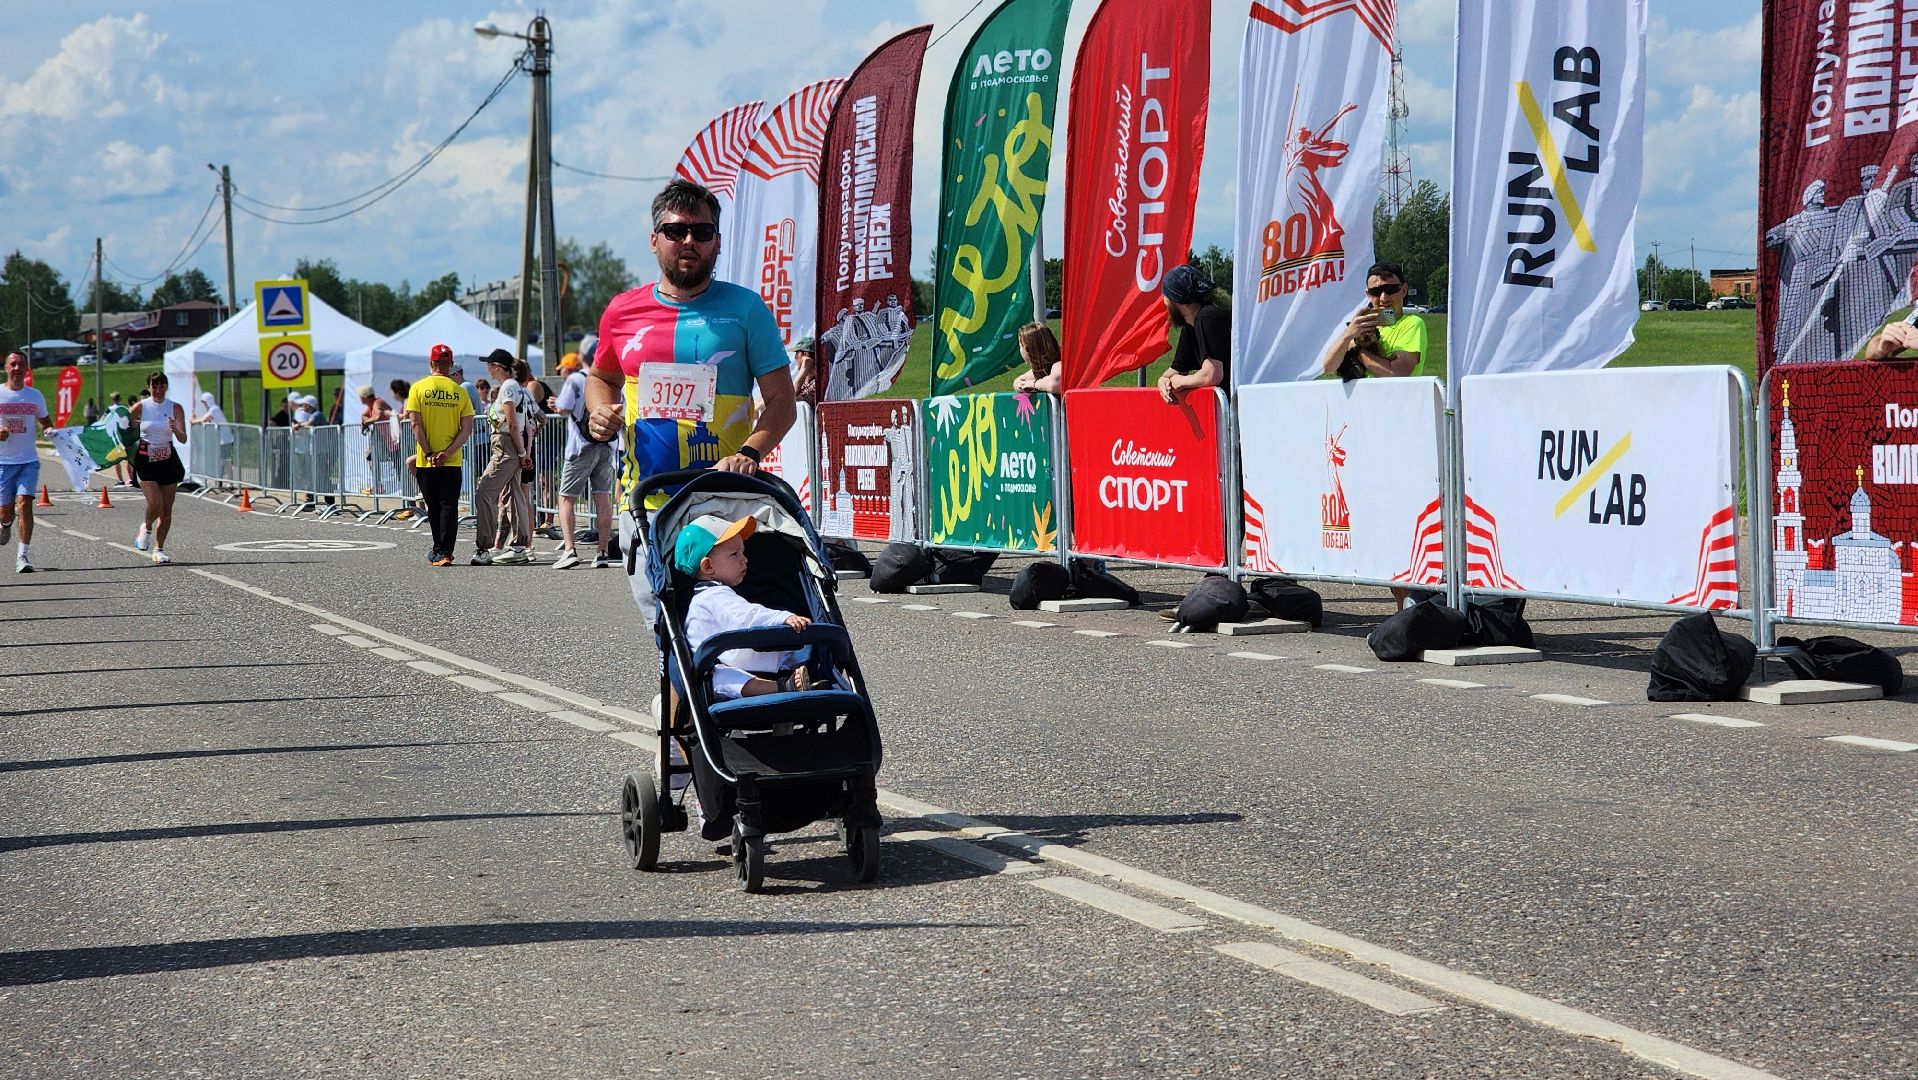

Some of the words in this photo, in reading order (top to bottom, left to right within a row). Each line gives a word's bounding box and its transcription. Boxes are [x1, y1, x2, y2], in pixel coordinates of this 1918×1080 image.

[1553, 46, 1600, 174] LAB
[1106, 84, 1132, 258] Советский
[1136, 53, 1170, 293] СПОРТ
[837, 149, 852, 292] Полумарафон
[869, 203, 893, 280] РУБЕЖ
[1263, 213, 1306, 269] 80
[1503, 152, 1556, 288] RUN
[760, 224, 778, 314] СОБЛ
[1258, 260, 1344, 303] ПОБЕДА!
[277, 352, 300, 370] 20
[425, 390, 459, 400] СУДЬЯ
[652, 382, 695, 406] 3197
[1111, 438, 1176, 467] Советский
[1538, 430, 1599, 481] RUN
[1099, 475, 1188, 512] СПОРТ
[1322, 493, 1337, 525] 80
[1588, 473, 1646, 526] LAB
